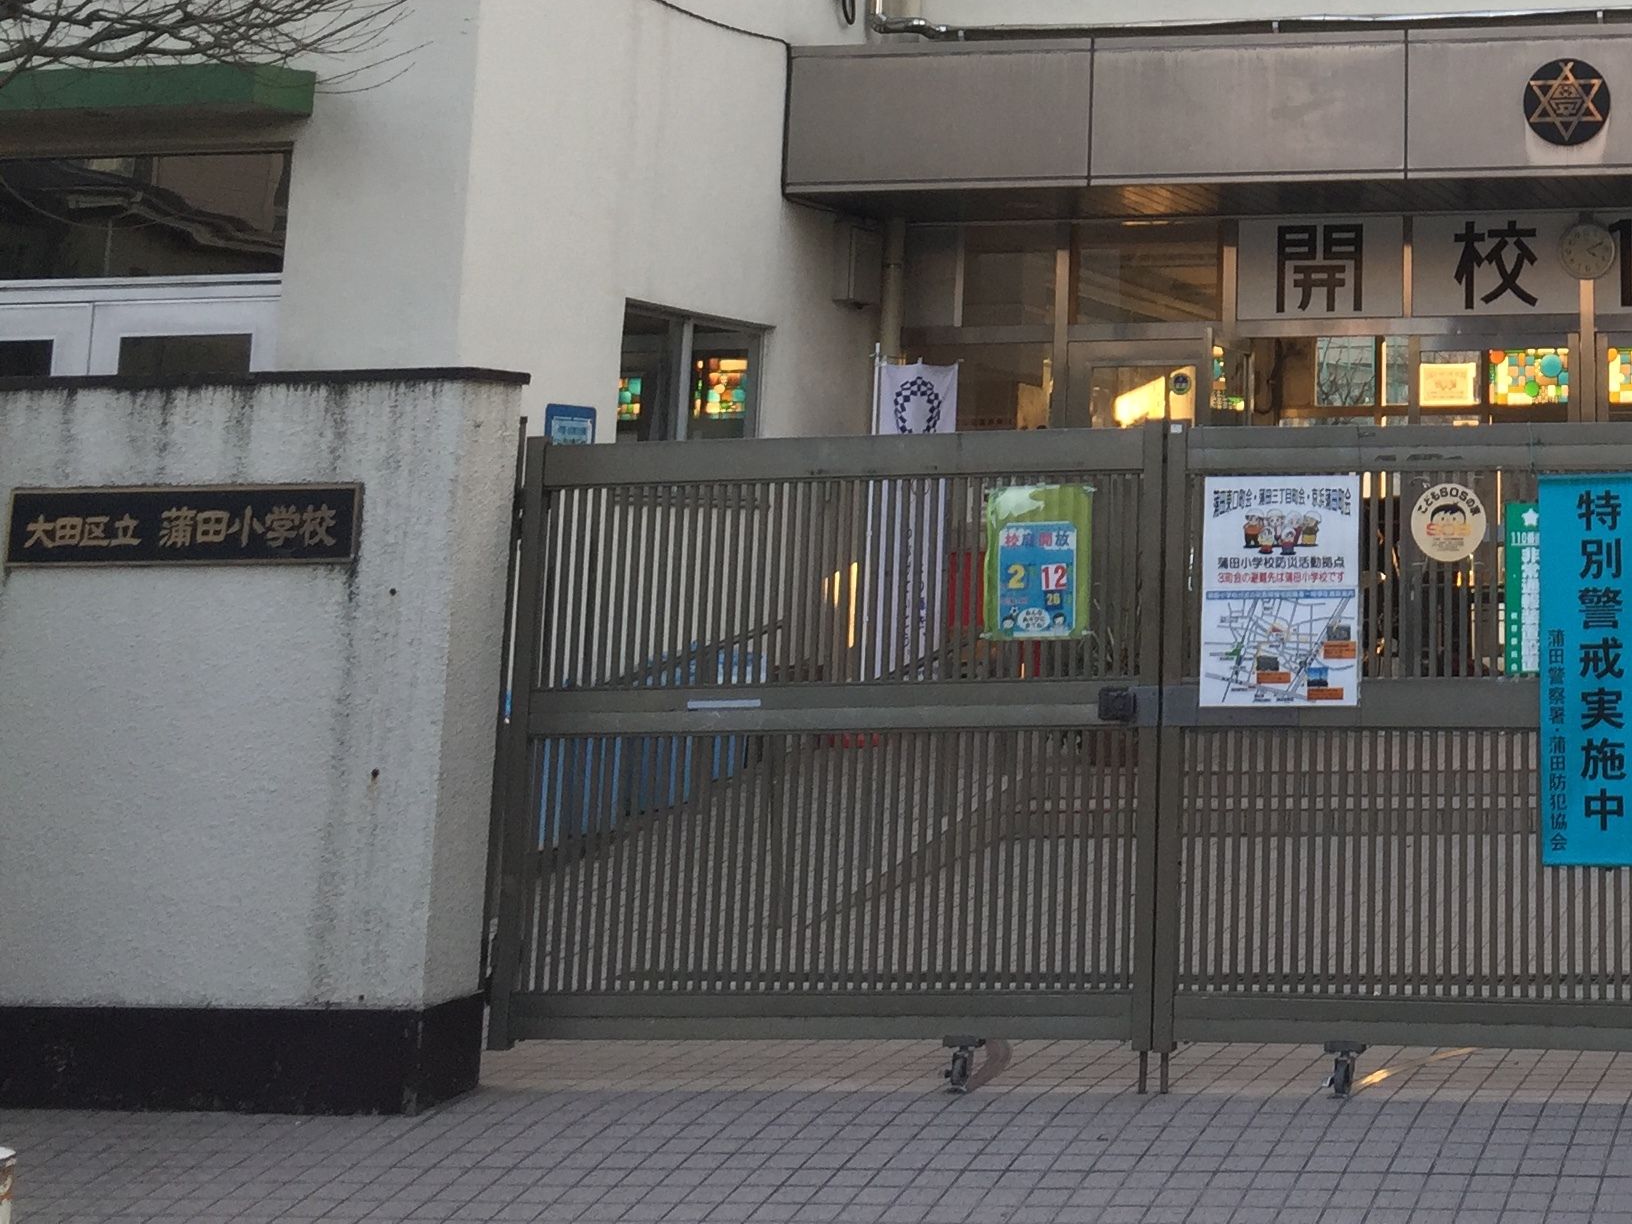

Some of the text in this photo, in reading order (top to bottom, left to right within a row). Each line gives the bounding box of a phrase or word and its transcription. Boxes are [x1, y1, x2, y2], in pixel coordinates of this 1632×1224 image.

[1417, 487, 1481, 516] こどもSOSの家
[24, 504, 338, 549] 大田区立 蒲田小学校
[1008, 564, 1025, 589] 2
[1042, 565, 1067, 589] 12
[1577, 489, 1627, 832] 特別警戒実施中
[1547, 629, 1567, 852] 蒲田警察署・蒲田防犯協会
